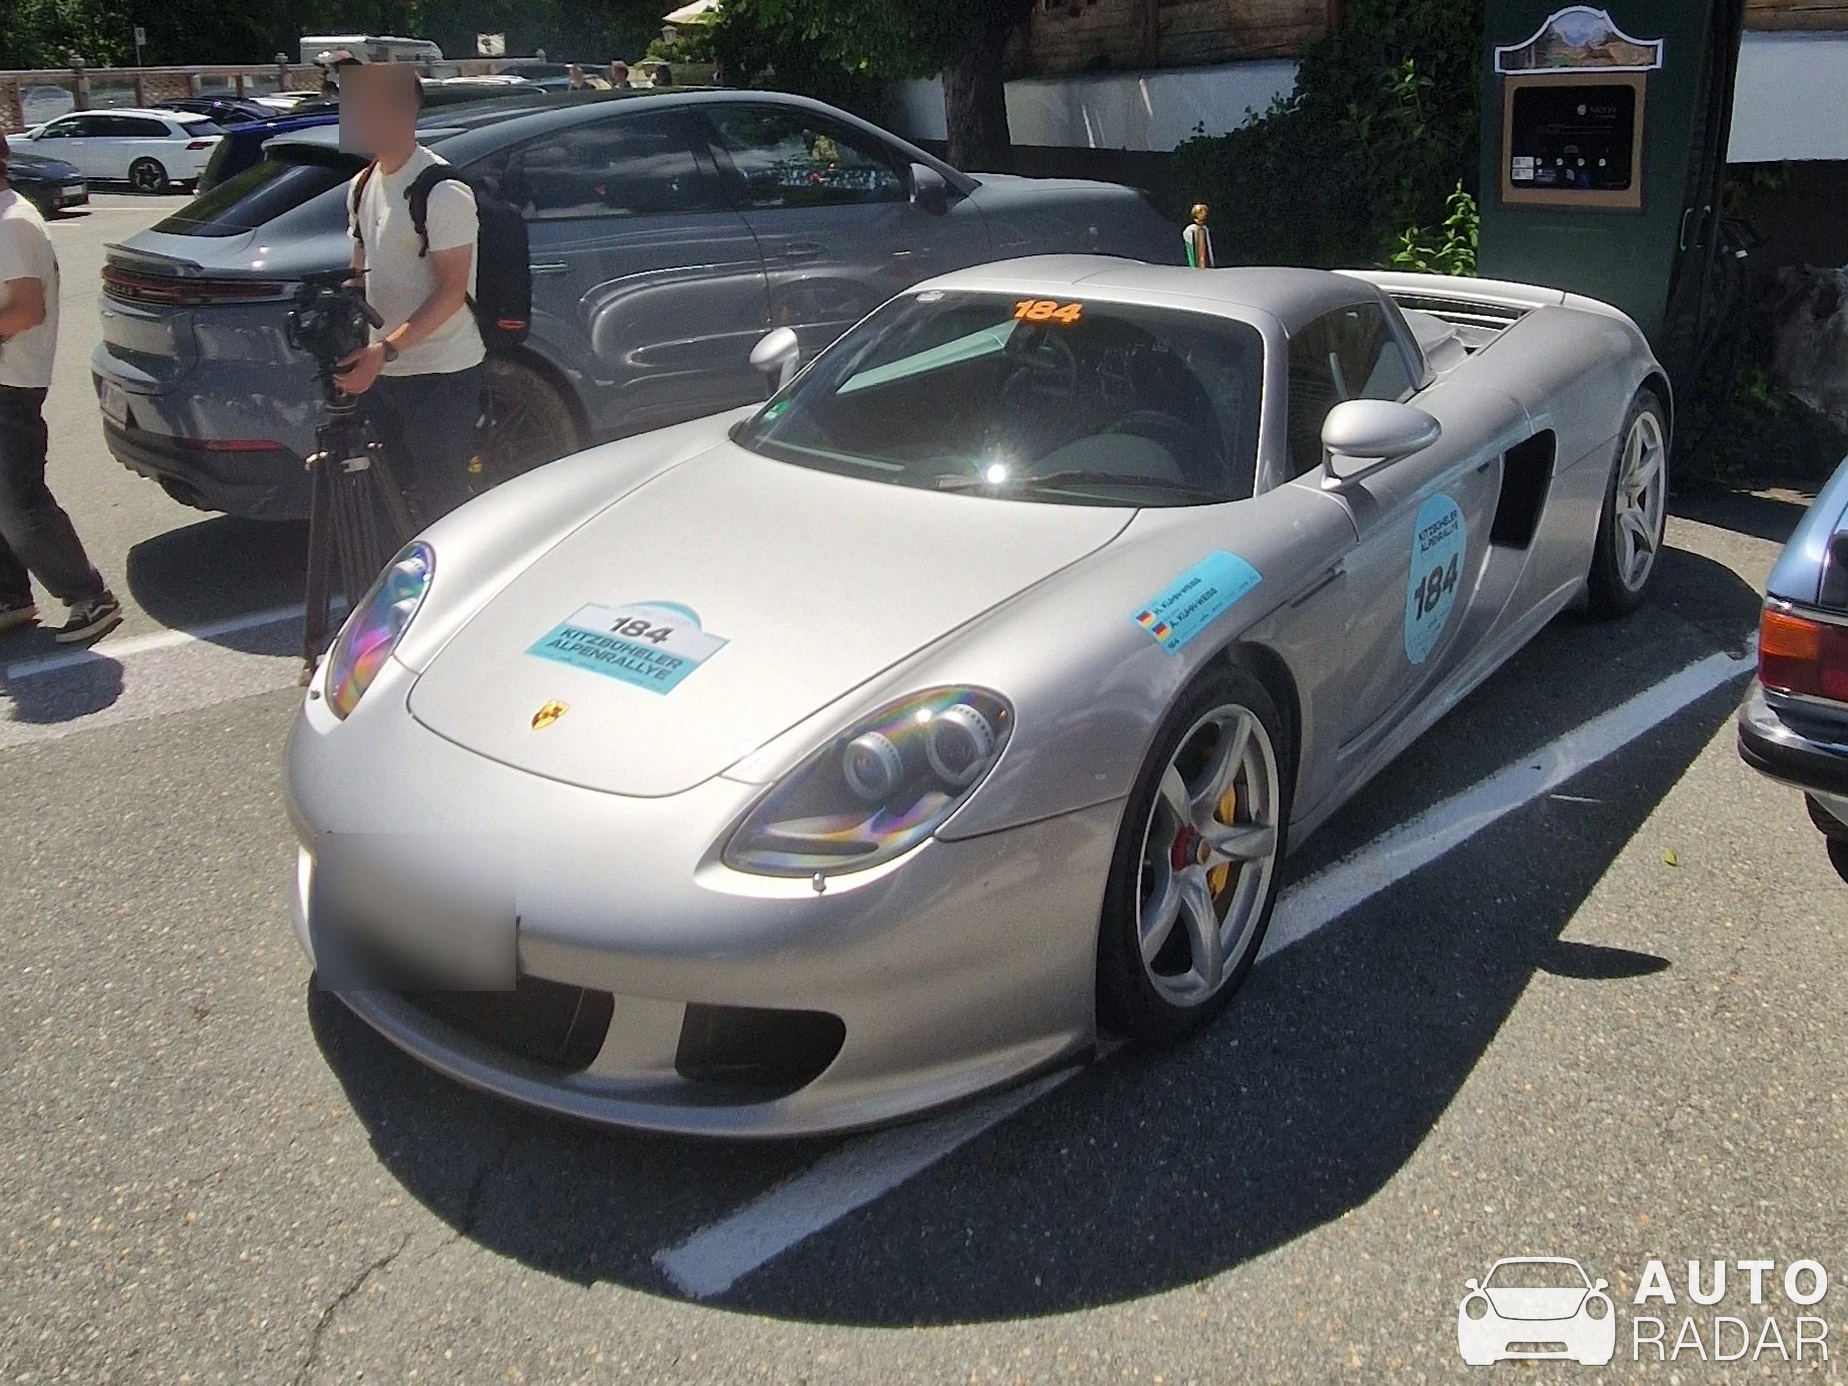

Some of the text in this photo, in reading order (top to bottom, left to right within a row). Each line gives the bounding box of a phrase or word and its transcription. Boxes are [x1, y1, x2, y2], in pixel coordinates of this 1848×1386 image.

[1014, 300, 1082, 322] 184
[1414, 552, 1459, 621] 184
[609, 617, 674, 644] 184
[546, 639, 672, 680] ALPENRALLYE
